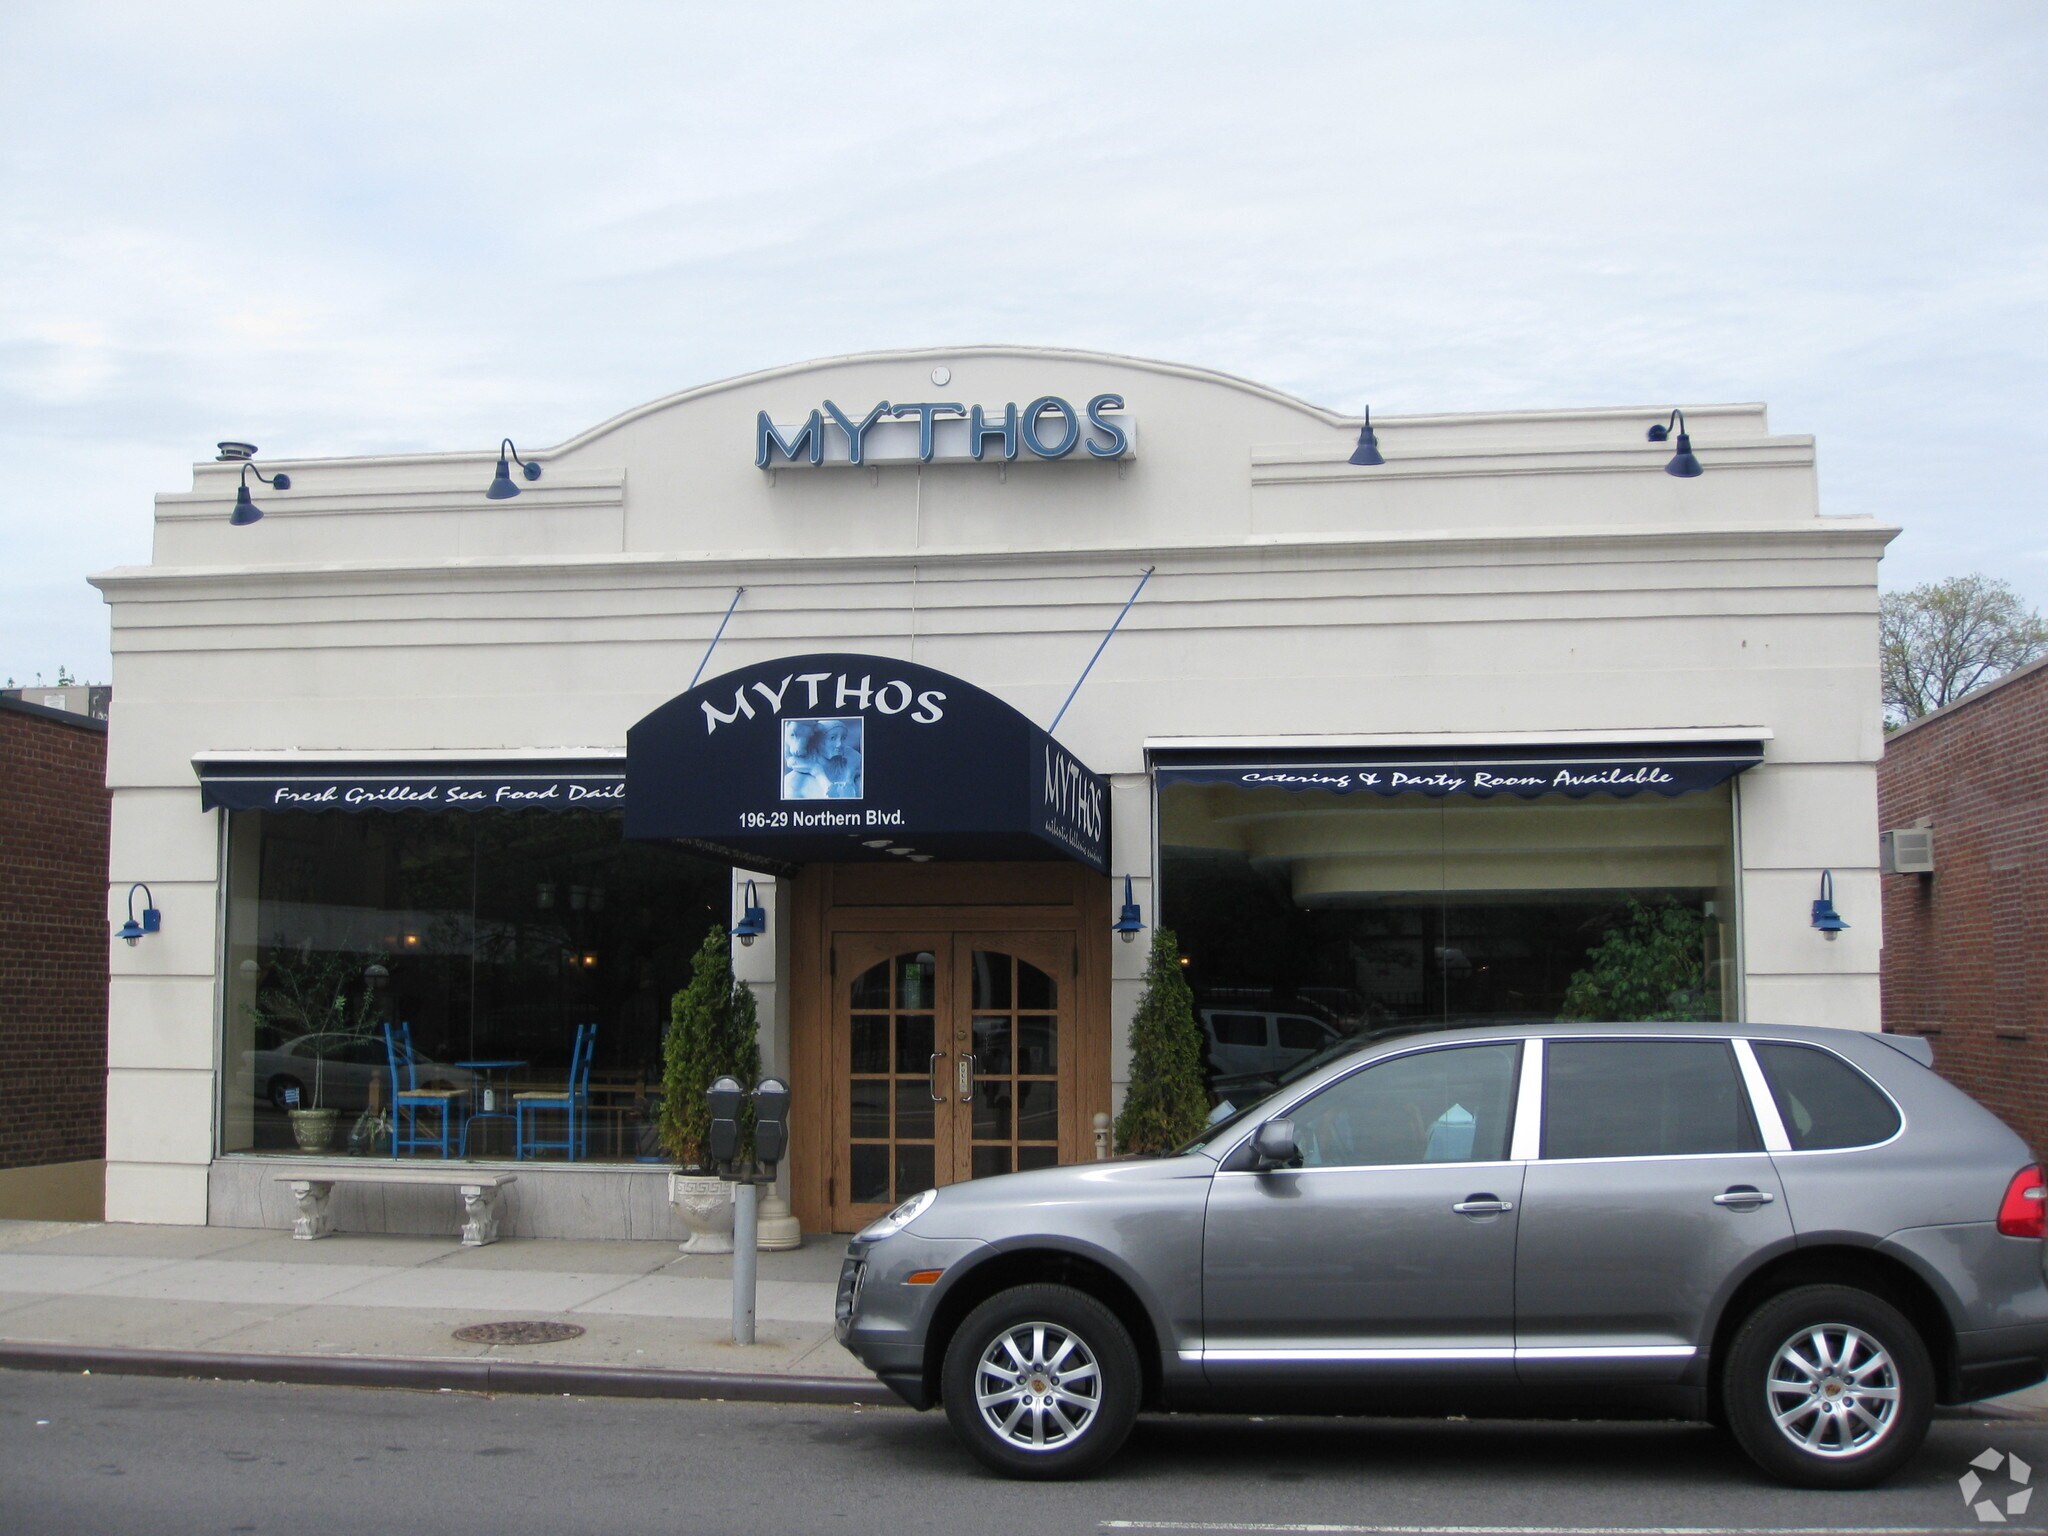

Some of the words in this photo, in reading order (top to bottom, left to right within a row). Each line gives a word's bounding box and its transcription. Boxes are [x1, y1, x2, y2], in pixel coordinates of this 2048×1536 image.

[755, 394, 1128, 469] MYTHOS
[701, 673, 947, 735] MYTHOS
[275, 786, 338, 803] Fresh
[345, 786, 438, 804] Grilled
[445, 786, 487, 802] Sea
[495, 784, 560, 802] Food
[1044, 744, 1102, 842] MYTHOS
[1242, 773, 1351, 788] Catering
[1359, 772, 1381, 786] &
[1391, 772, 1466, 791] Party
[1474, 772, 1546, 788] Room
[1553, 767, 1673, 787] Available
[739, 811, 788, 828] 196-29
[793, 810, 861, 827] Northern
[866, 809, 905, 825] Blvd.
